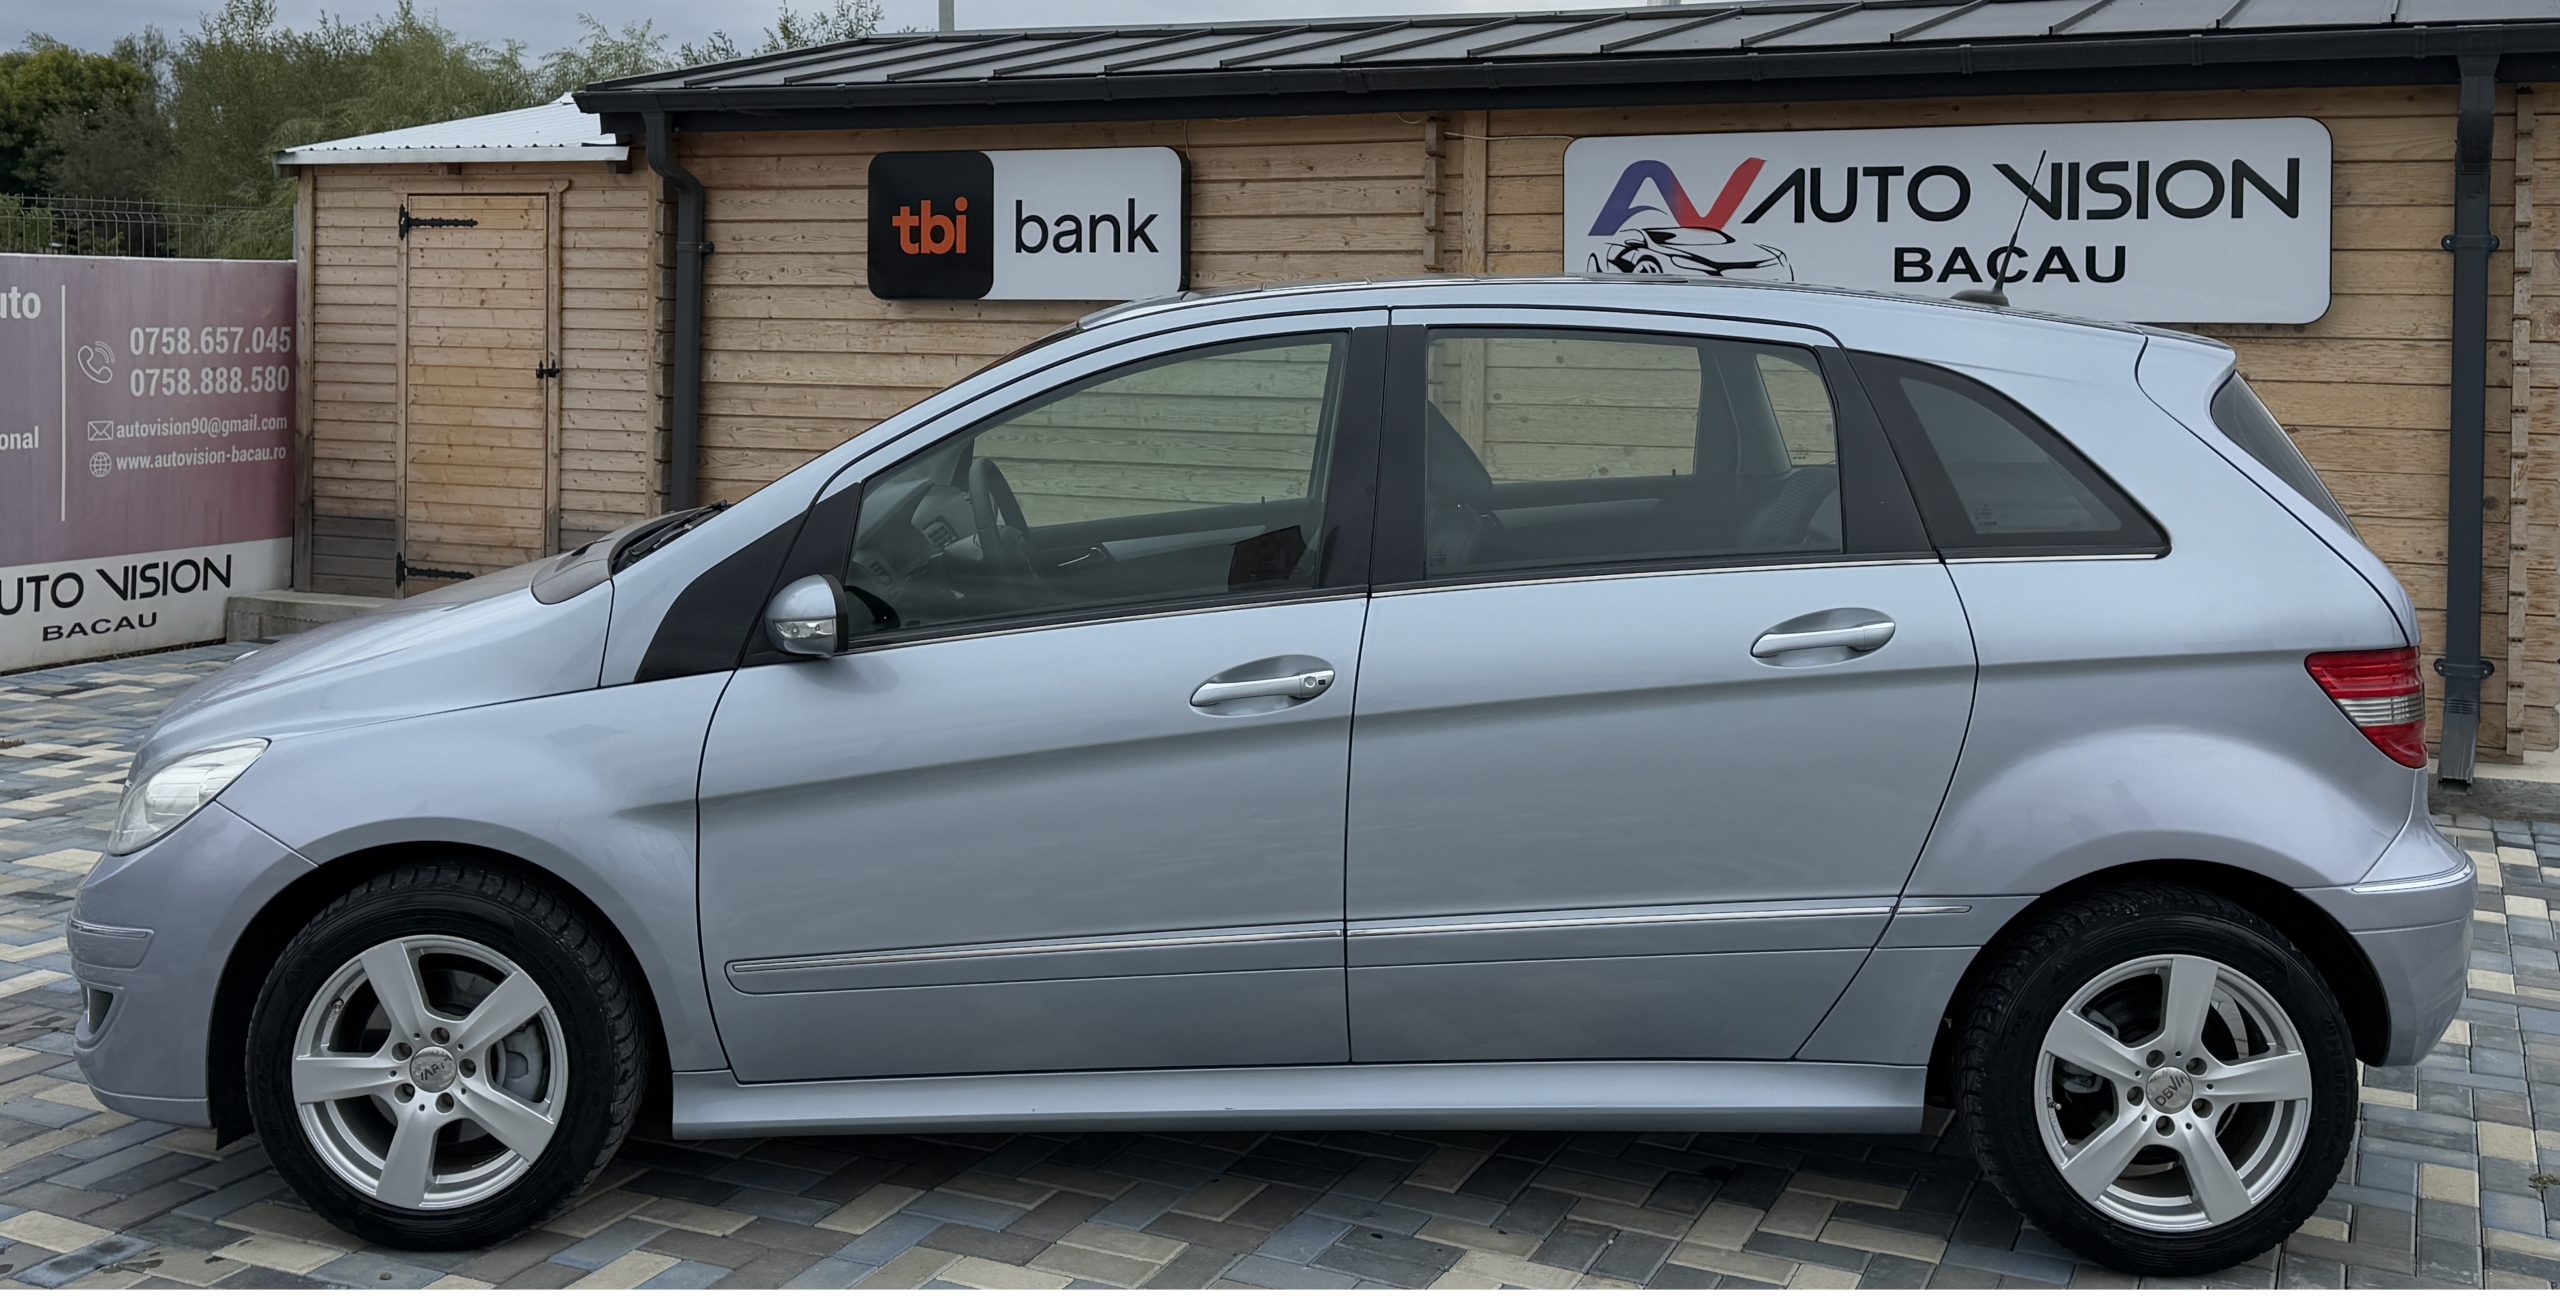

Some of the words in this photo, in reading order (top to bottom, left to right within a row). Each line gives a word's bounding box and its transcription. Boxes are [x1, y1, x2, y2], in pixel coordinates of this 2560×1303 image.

[1741, 165, 1971, 224] AUTO
[1992, 157, 2300, 220] VISION
[891, 196, 969, 255] tbi
[1014, 197, 1160, 254] bank
[1893, 245, 2126, 284] BACAU
[129, 326, 292, 356] 0758.657.045
[129, 365, 291, 398] 0758.888.580
[116, 415, 288, 440] autovision90@gmail.com
[116, 446, 287, 471] www.autovision-bacau.ro
[95, 553, 232, 601] VISION
[42, 612, 157, 642] BACAU
